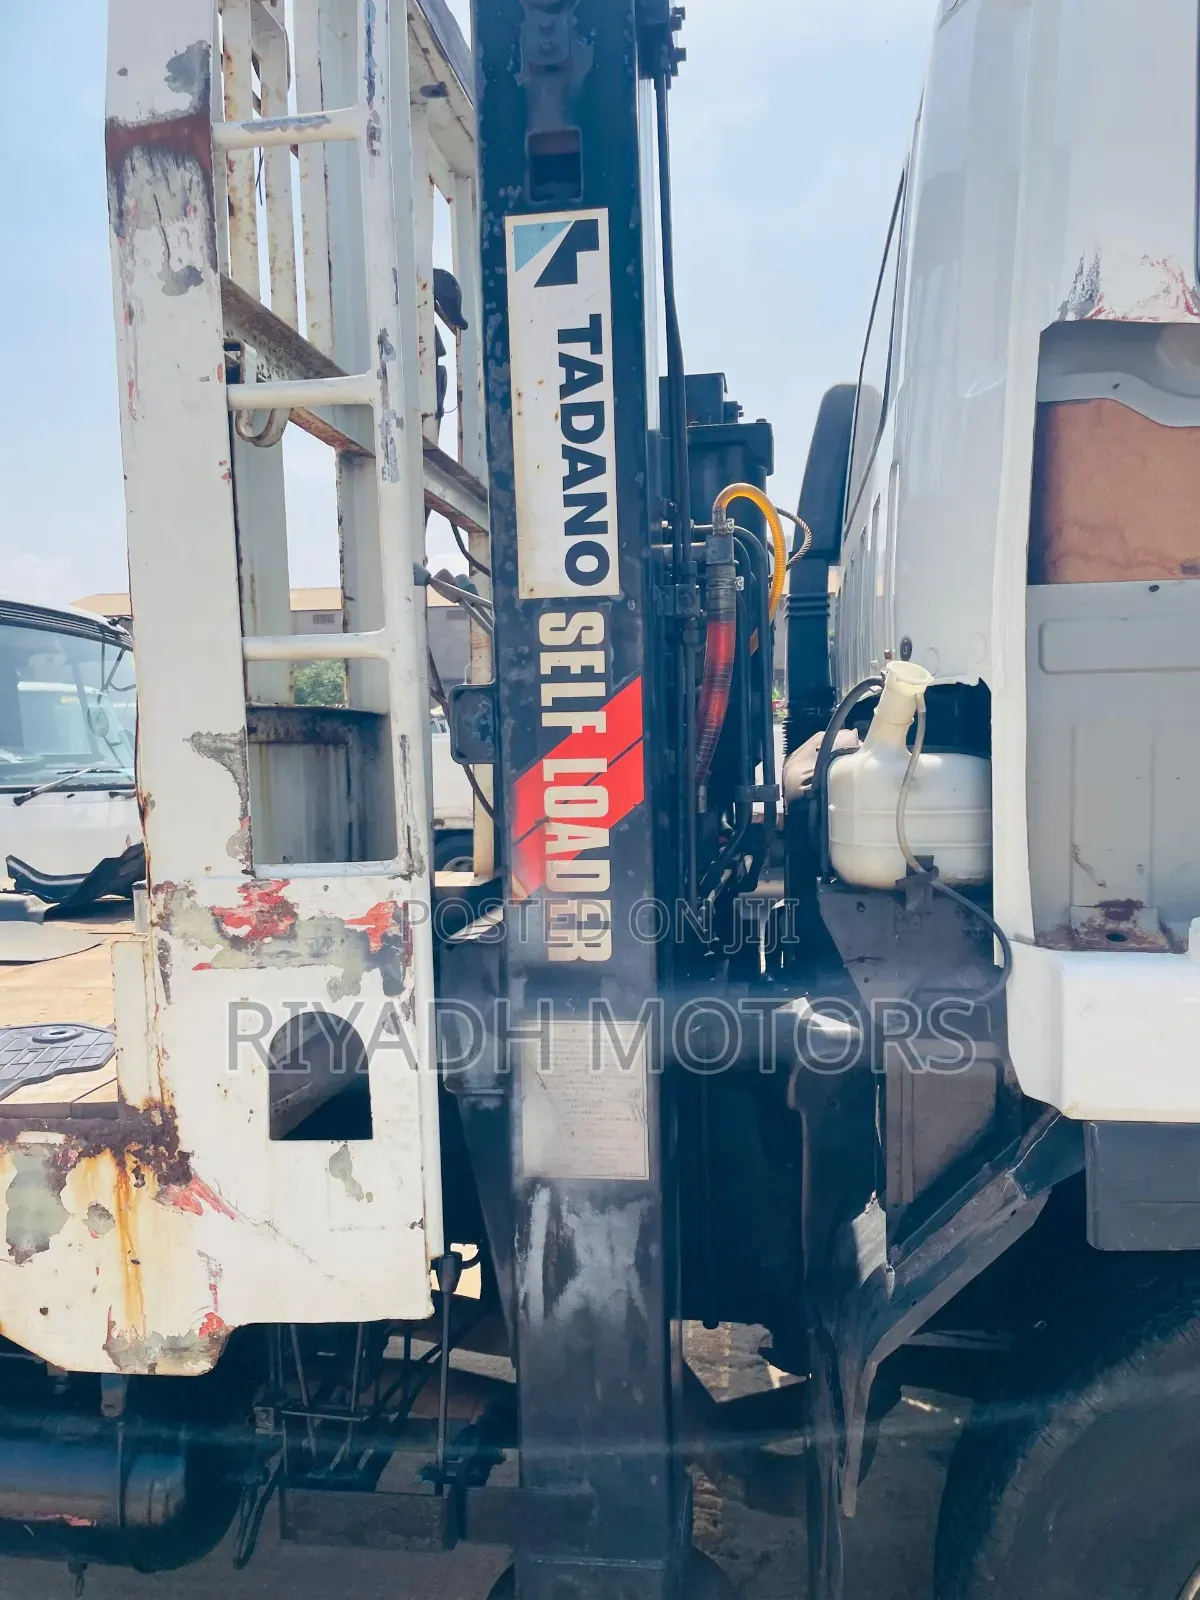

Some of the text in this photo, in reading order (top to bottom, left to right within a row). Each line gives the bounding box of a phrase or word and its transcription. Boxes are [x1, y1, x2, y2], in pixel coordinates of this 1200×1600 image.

[557, 313, 610, 587] TADANO
[538, 611, 607, 734] SELF
[543, 757, 612, 963] LOADER
